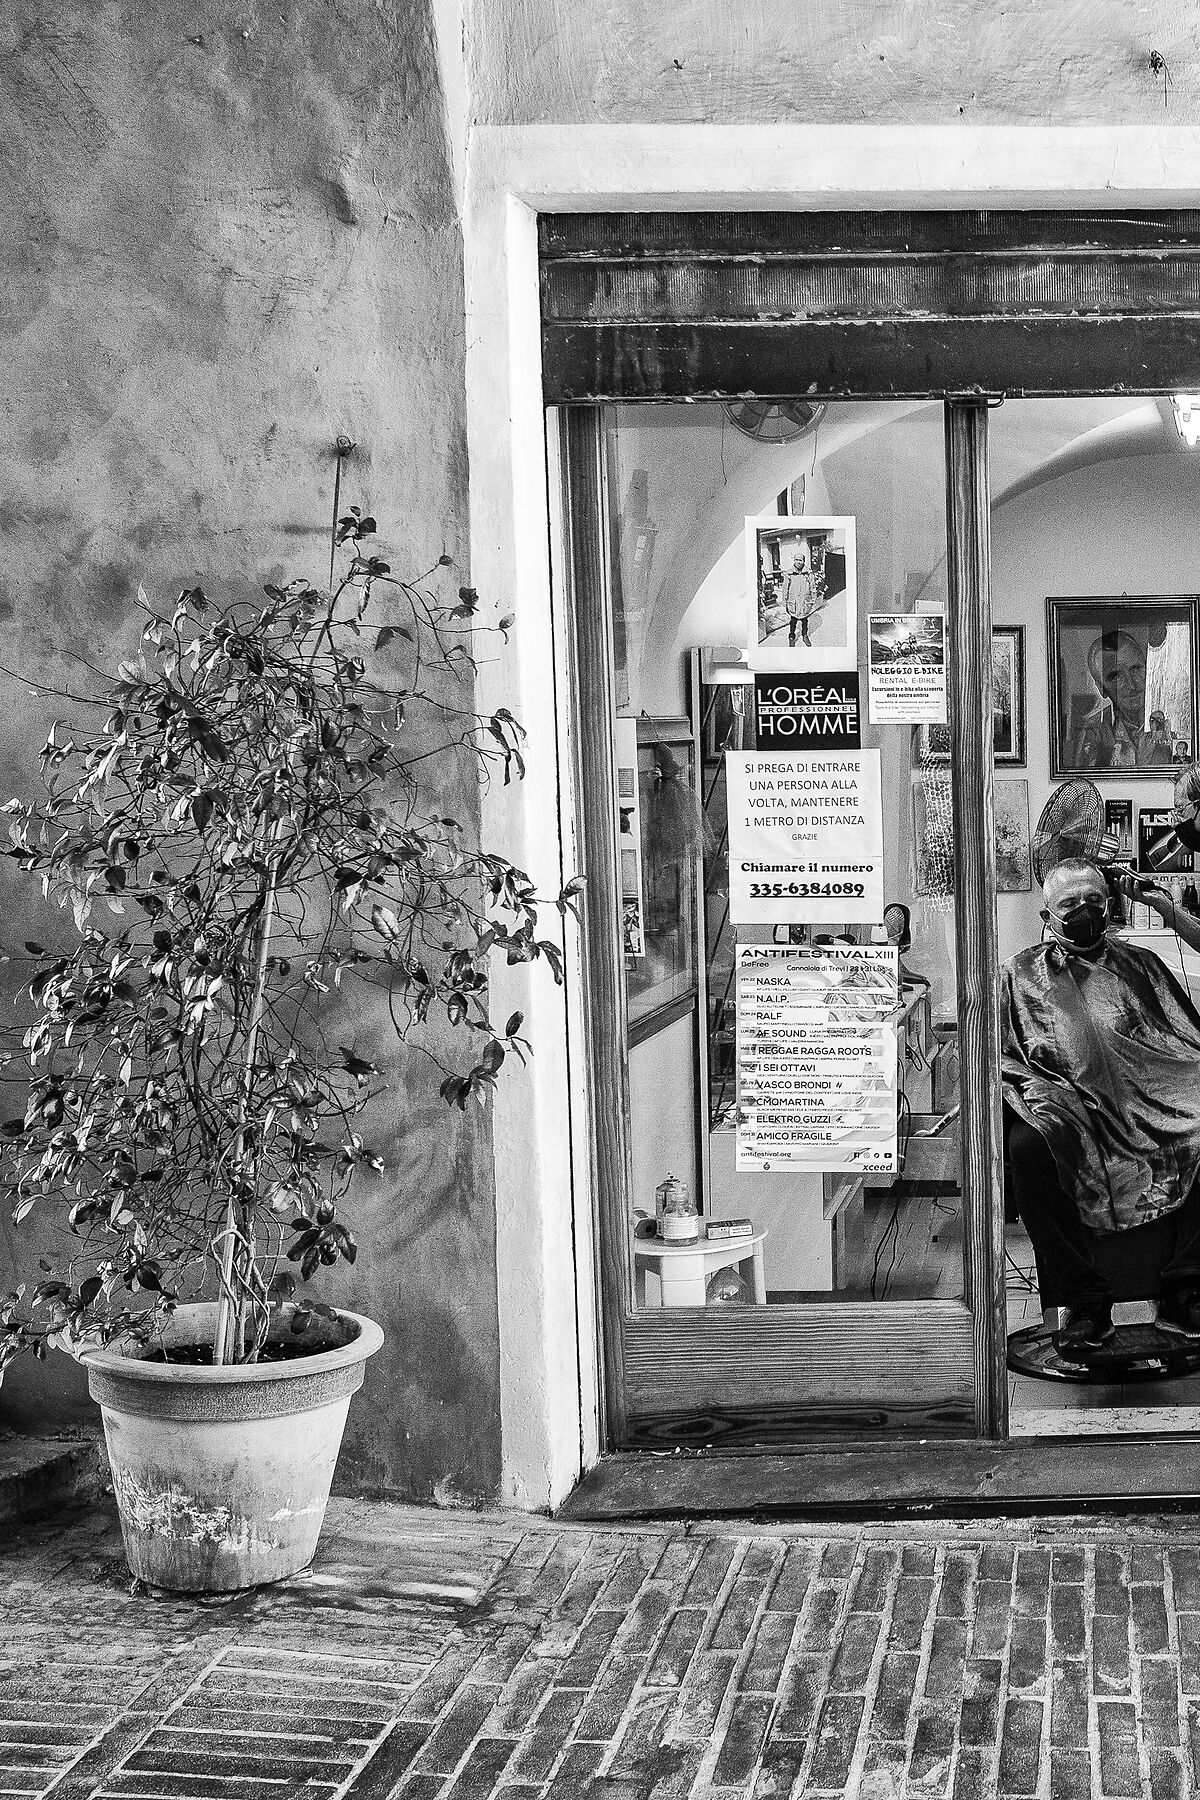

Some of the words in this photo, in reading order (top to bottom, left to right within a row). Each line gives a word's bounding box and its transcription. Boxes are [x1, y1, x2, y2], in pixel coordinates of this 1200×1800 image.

[758, 686, 857, 705] L'ORÉAL
[758, 714, 858, 736] HOMME
[745, 764, 754, 774] SI
[757, 763, 794, 773] PREGA
[797, 763, 808, 773] DI
[811, 763, 861, 772] ENTRARE
[749, 781, 775, 791] UNA
[777, 780, 828, 790] PERSONA
[831, 779, 858, 790] ALLA
[748, 798, 788, 809] VOLTA,
[791, 797, 859, 807] MANTENERE
[745, 817, 751, 827] 1
[754, 816, 794, 826] METRO
[797, 816, 808, 826] DI
[811, 815, 865, 826] DISTANZA
[792, 833, 818, 841] GRAZIE
[741, 863, 806, 873] Chiamare
[808, 863, 818, 873] il
[821, 864, 874, 873] numero
[749, 882, 865, 897] 335-6384089
[756, 995, 790, 1003] N.A.I.P.
[756, 1012, 782, 1020] RALF
[800, 1047, 835, 1055] RAGGA
[757, 1081, 792, 1089] VASCO
[794, 1081, 831, 1089] BRONDI
[756, 1115, 801, 1123] ELEKTRO
[756, 1132, 789, 1140] AMICO
[862, 1163, 893, 1171] xceed
